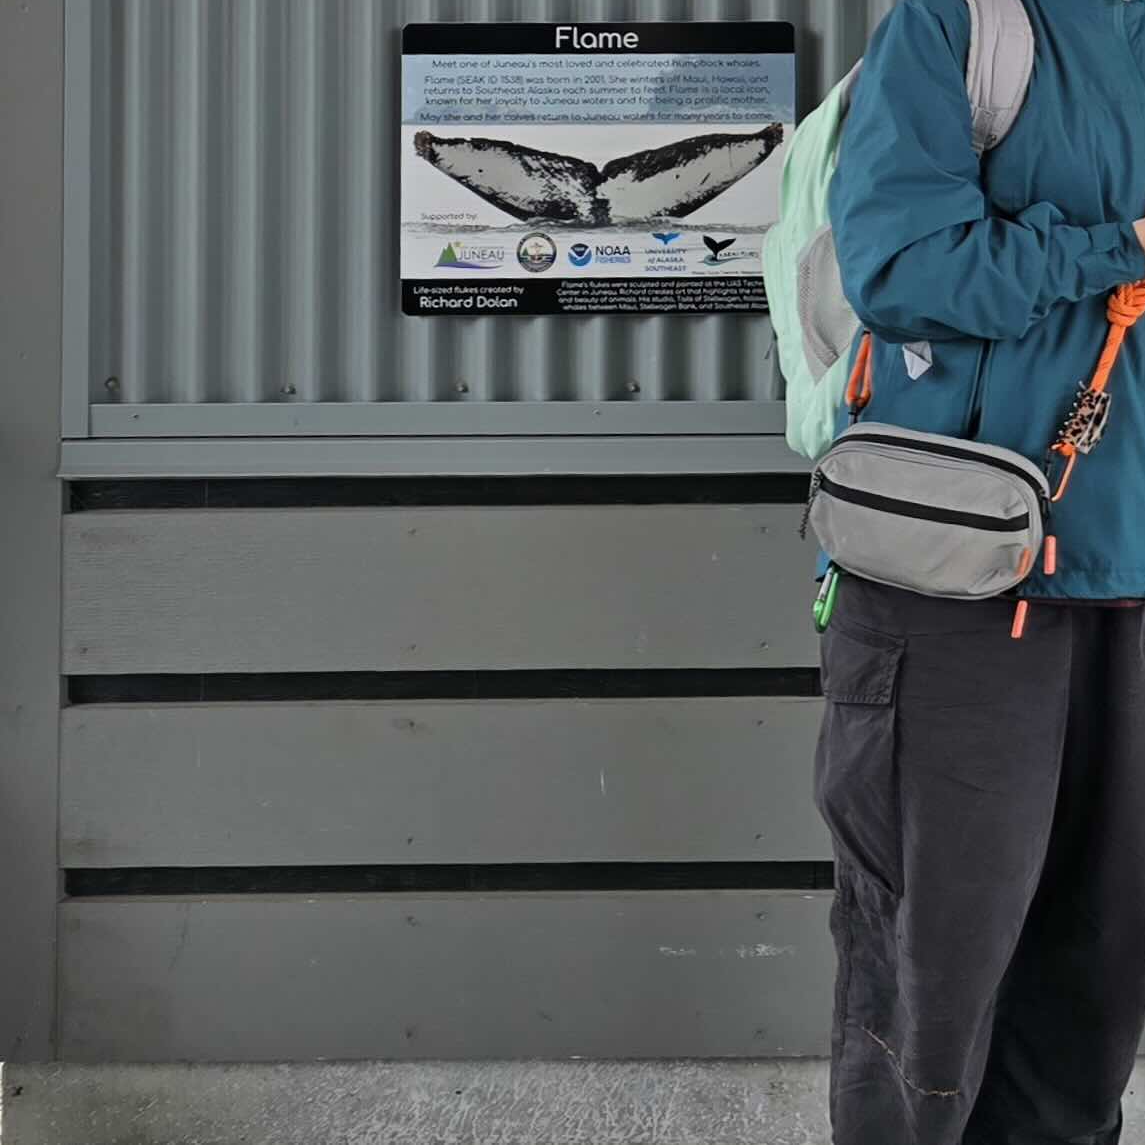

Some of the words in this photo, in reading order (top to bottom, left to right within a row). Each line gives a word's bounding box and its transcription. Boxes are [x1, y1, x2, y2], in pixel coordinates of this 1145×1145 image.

[555, 27, 639, 49] Flame
[432, 59, 457, 68] Meet
[480, 59, 491, 68] of
[493, 59, 536, 68] Juneau's
[539, 59, 563, 68] most
[566, 59, 593, 68] loved
[594, 59, 614, 68] and
[616, 59, 670, 68] celebrated
[671, 59, 722, 70] humpback
[424, 75, 455, 84] Flame
[488, 75, 498, 84] ID
[546, 75, 570, 84] born
[573, 75, 583, 84] in
[608, 75, 627, 84] She
[629, 75, 664, 84] winters
[666, 75, 680, 84] off
[748, 75, 768, 84] and
[423, 86, 460, 95] returns
[462, 86, 472, 95] to
[475, 86, 525, 95] Southeast
[527, 86, 560, 95] Alaska
[562, 86, 586, 95] each
[630, 86, 641, 95] to
[669, 86, 698, 95] Flame
[702, 86, 710, 95] is
[720, 86, 745, 95] local
[425, 96, 457, 105] known
[459, 96, 473, 105] for
[476, 96, 492, 105] her
[495, 96, 528, 107] loyalty
[530, 96, 540, 105] to
[542, 96, 580, 105] Juneau
[582, 96, 614, 105] waters
[616, 96, 636, 105] and
[638, 96, 653, 105] for
[655, 96, 683, 107] being
[694, 96, 728, 107] prolific
[420, 112, 442, 123] May
[443, 112, 461, 121] she
[463, 112, 483, 121] and
[485, 112, 501, 121] her
[503, 112, 534, 121] calves
[537, 112, 569, 121] return
[571, 112, 581, 121] to
[583, 112, 620, 121] Juneau
[622, 112, 654, 121] waters
[656, 112, 672, 121] for
[674, 114, 701, 123] many
[703, 114, 730, 123] years
[732, 112, 742, 121] to
[458, 249, 505, 260] JUNEAU
[595, 245, 631, 256] NOAA
[413, 286, 453, 294] Life-sized
[454, 286, 479, 294] flukes
[480, 286, 512, 294] created
[513, 286, 524, 295] by
[419, 296, 473, 308] Richard
[476, 296, 518, 308] Dolan
